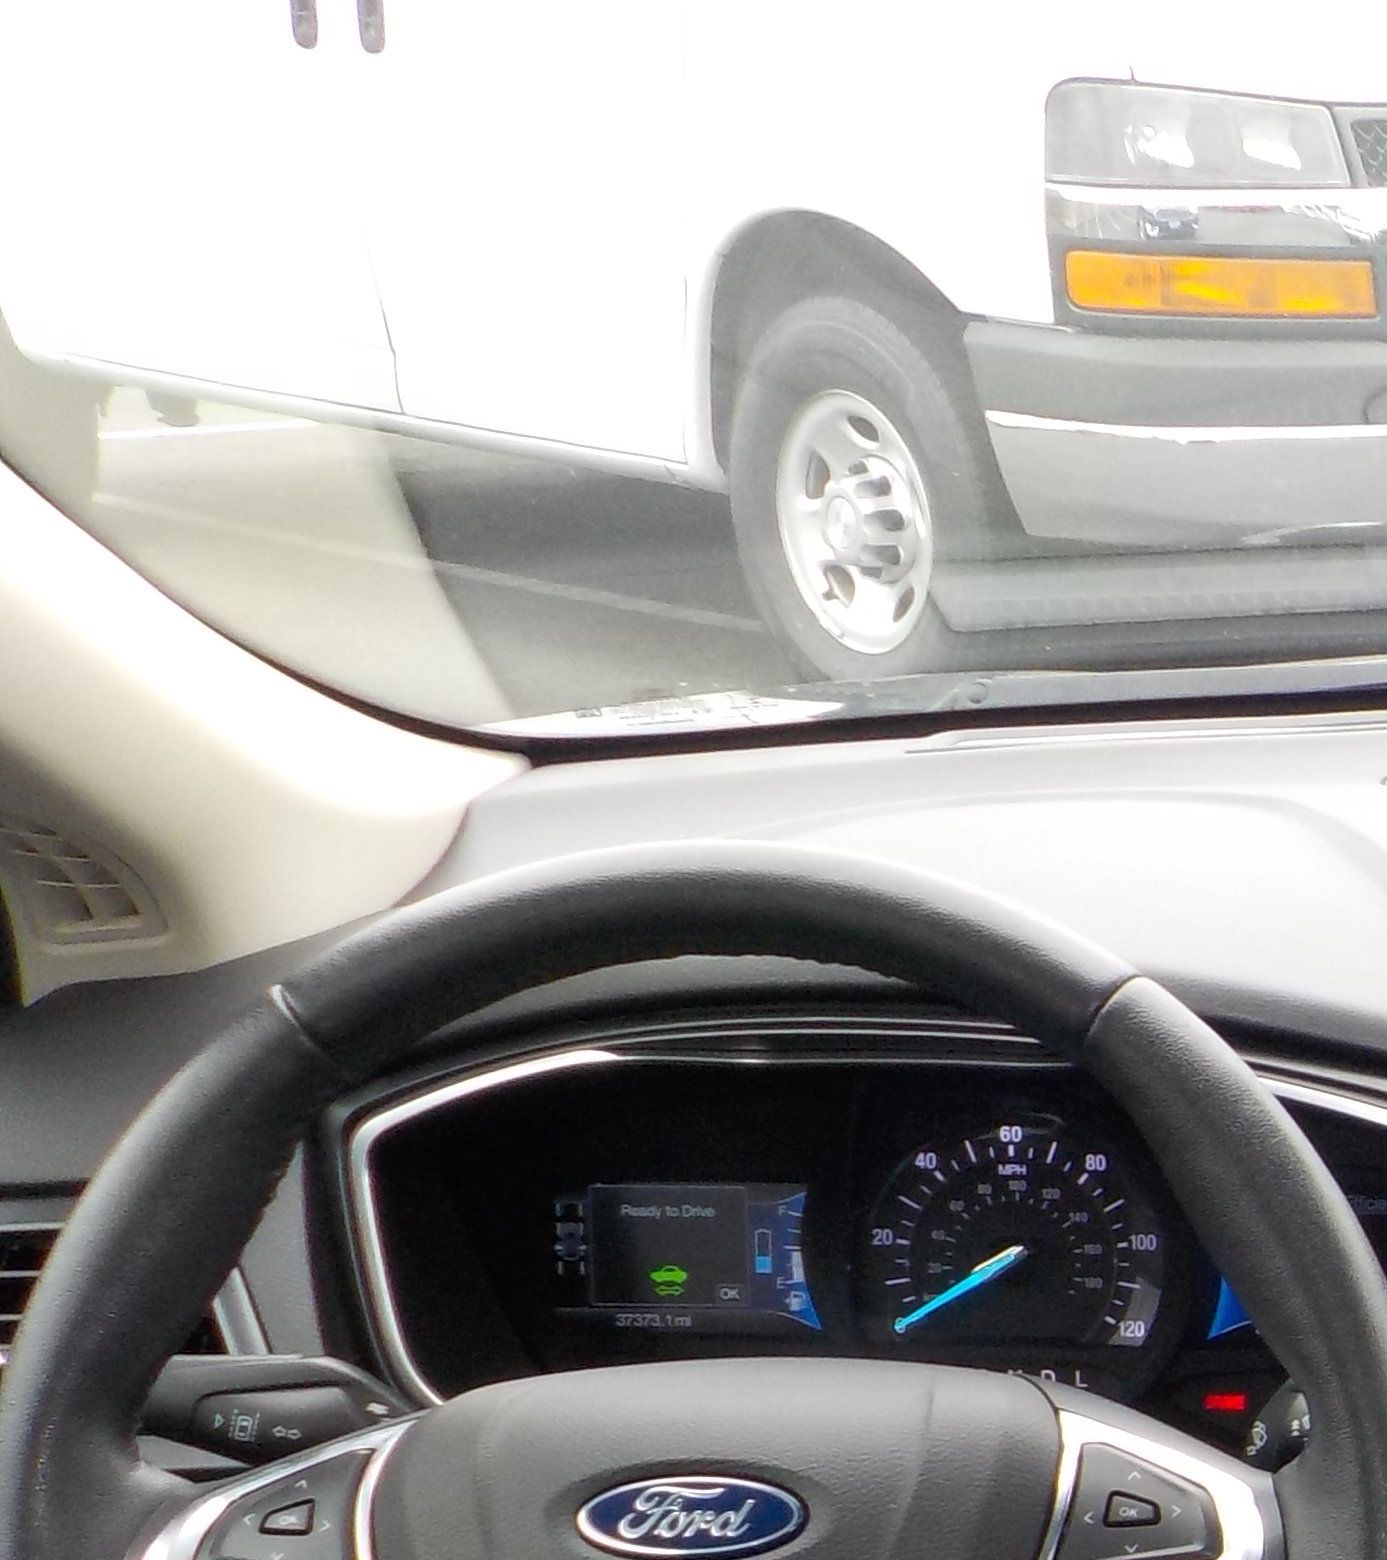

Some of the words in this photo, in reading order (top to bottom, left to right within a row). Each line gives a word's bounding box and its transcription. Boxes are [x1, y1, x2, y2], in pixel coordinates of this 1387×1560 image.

[1000, 1126, 1022, 1142] 60
[914, 1152, 937, 1169] 40
[1085, 1154, 1107, 1171] 80
[998, 1164, 1027, 1176] MPH
[620, 1205, 661, 1219] Ready
[666, 1205, 679, 1217] to
[682, 1205, 716, 1217] Drive
[778, 1205, 787, 1216] F
[872, 1228, 893, 1245] 20
[1130, 1234, 1157, 1251] 100
[776, 1277, 785, 1289] E
[720, 1288, 740, 1299] OK
[1118, 1320, 1145, 1337] 120
[1075, 1370, 1088, 1387] L
[618, 1485, 756, 1539] Ford
[1118, 1506, 1138, 1518] OK
